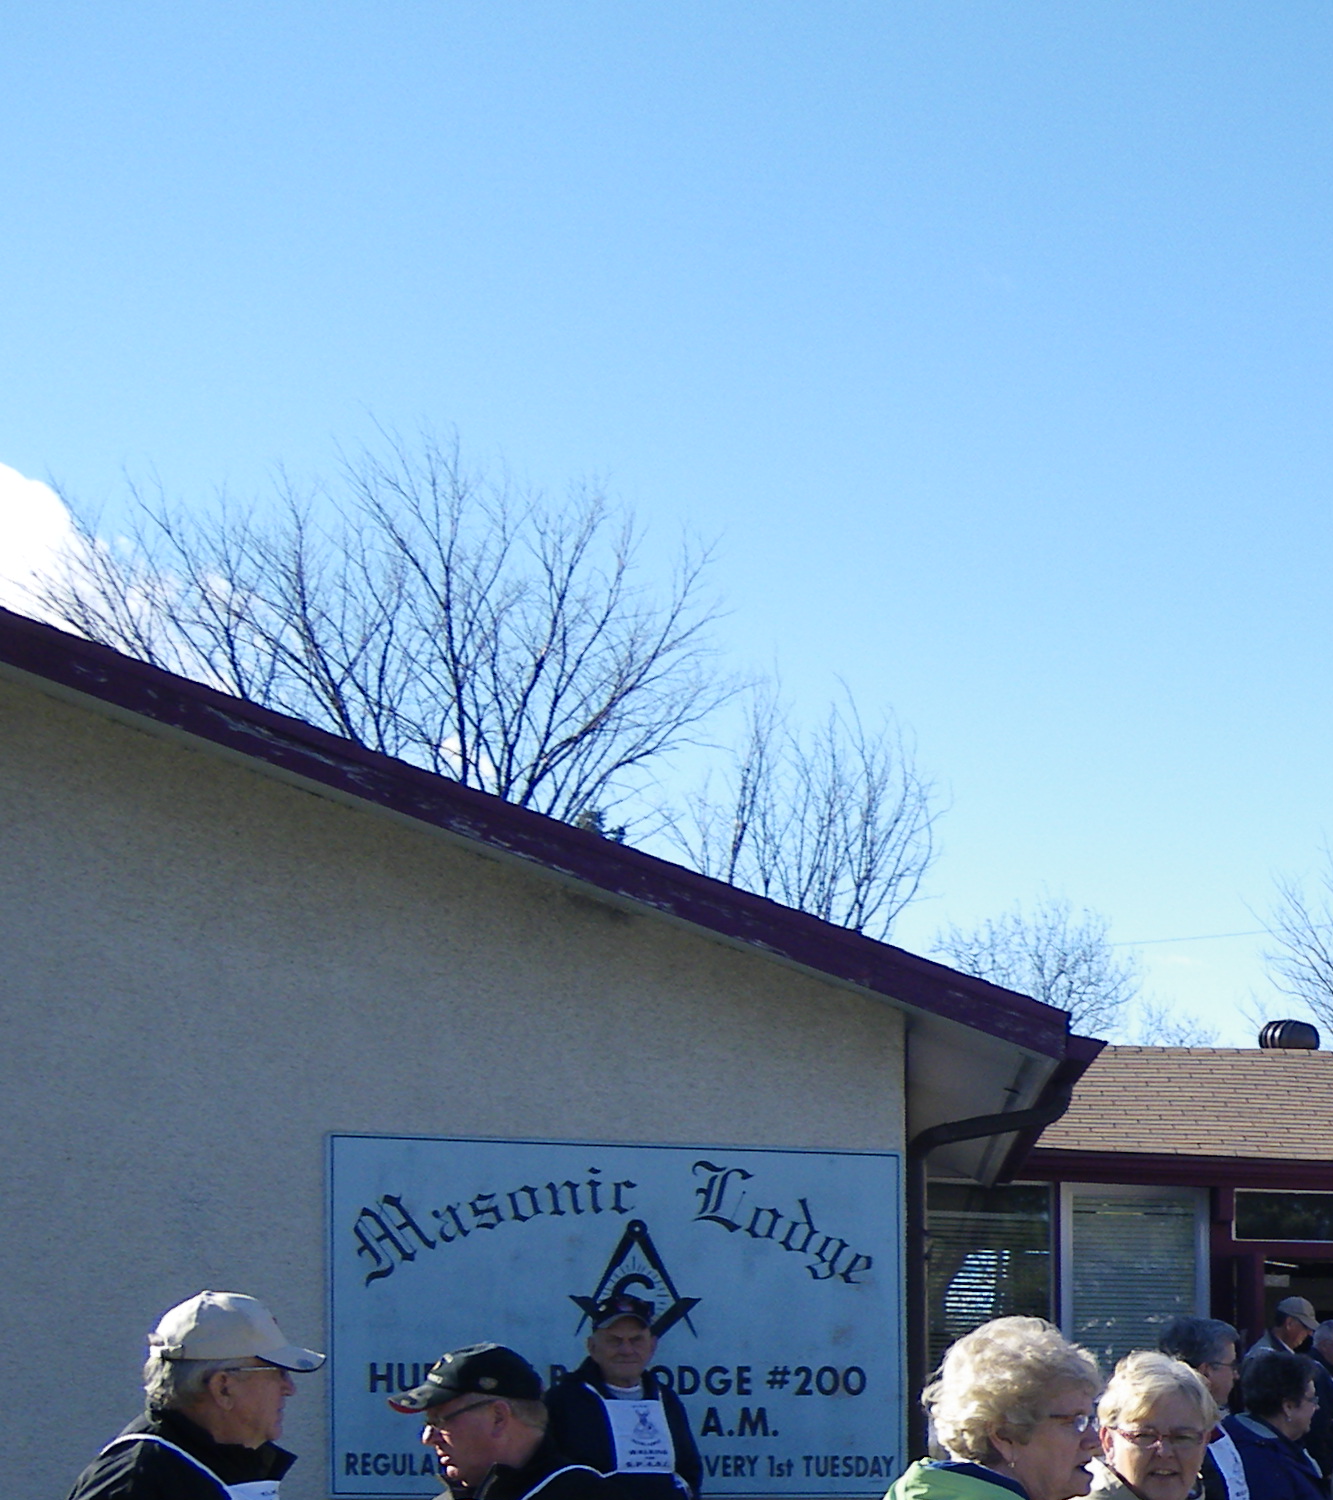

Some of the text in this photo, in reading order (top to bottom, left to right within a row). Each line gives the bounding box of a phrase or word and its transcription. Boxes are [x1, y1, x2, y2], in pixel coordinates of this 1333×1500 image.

[352, 1160, 873, 1287] Masonic Lodge
[651, 1365, 867, 1396] ODGE #200
[345, 1453, 895, 1477] REGULA VERY 1st TUESDAY
